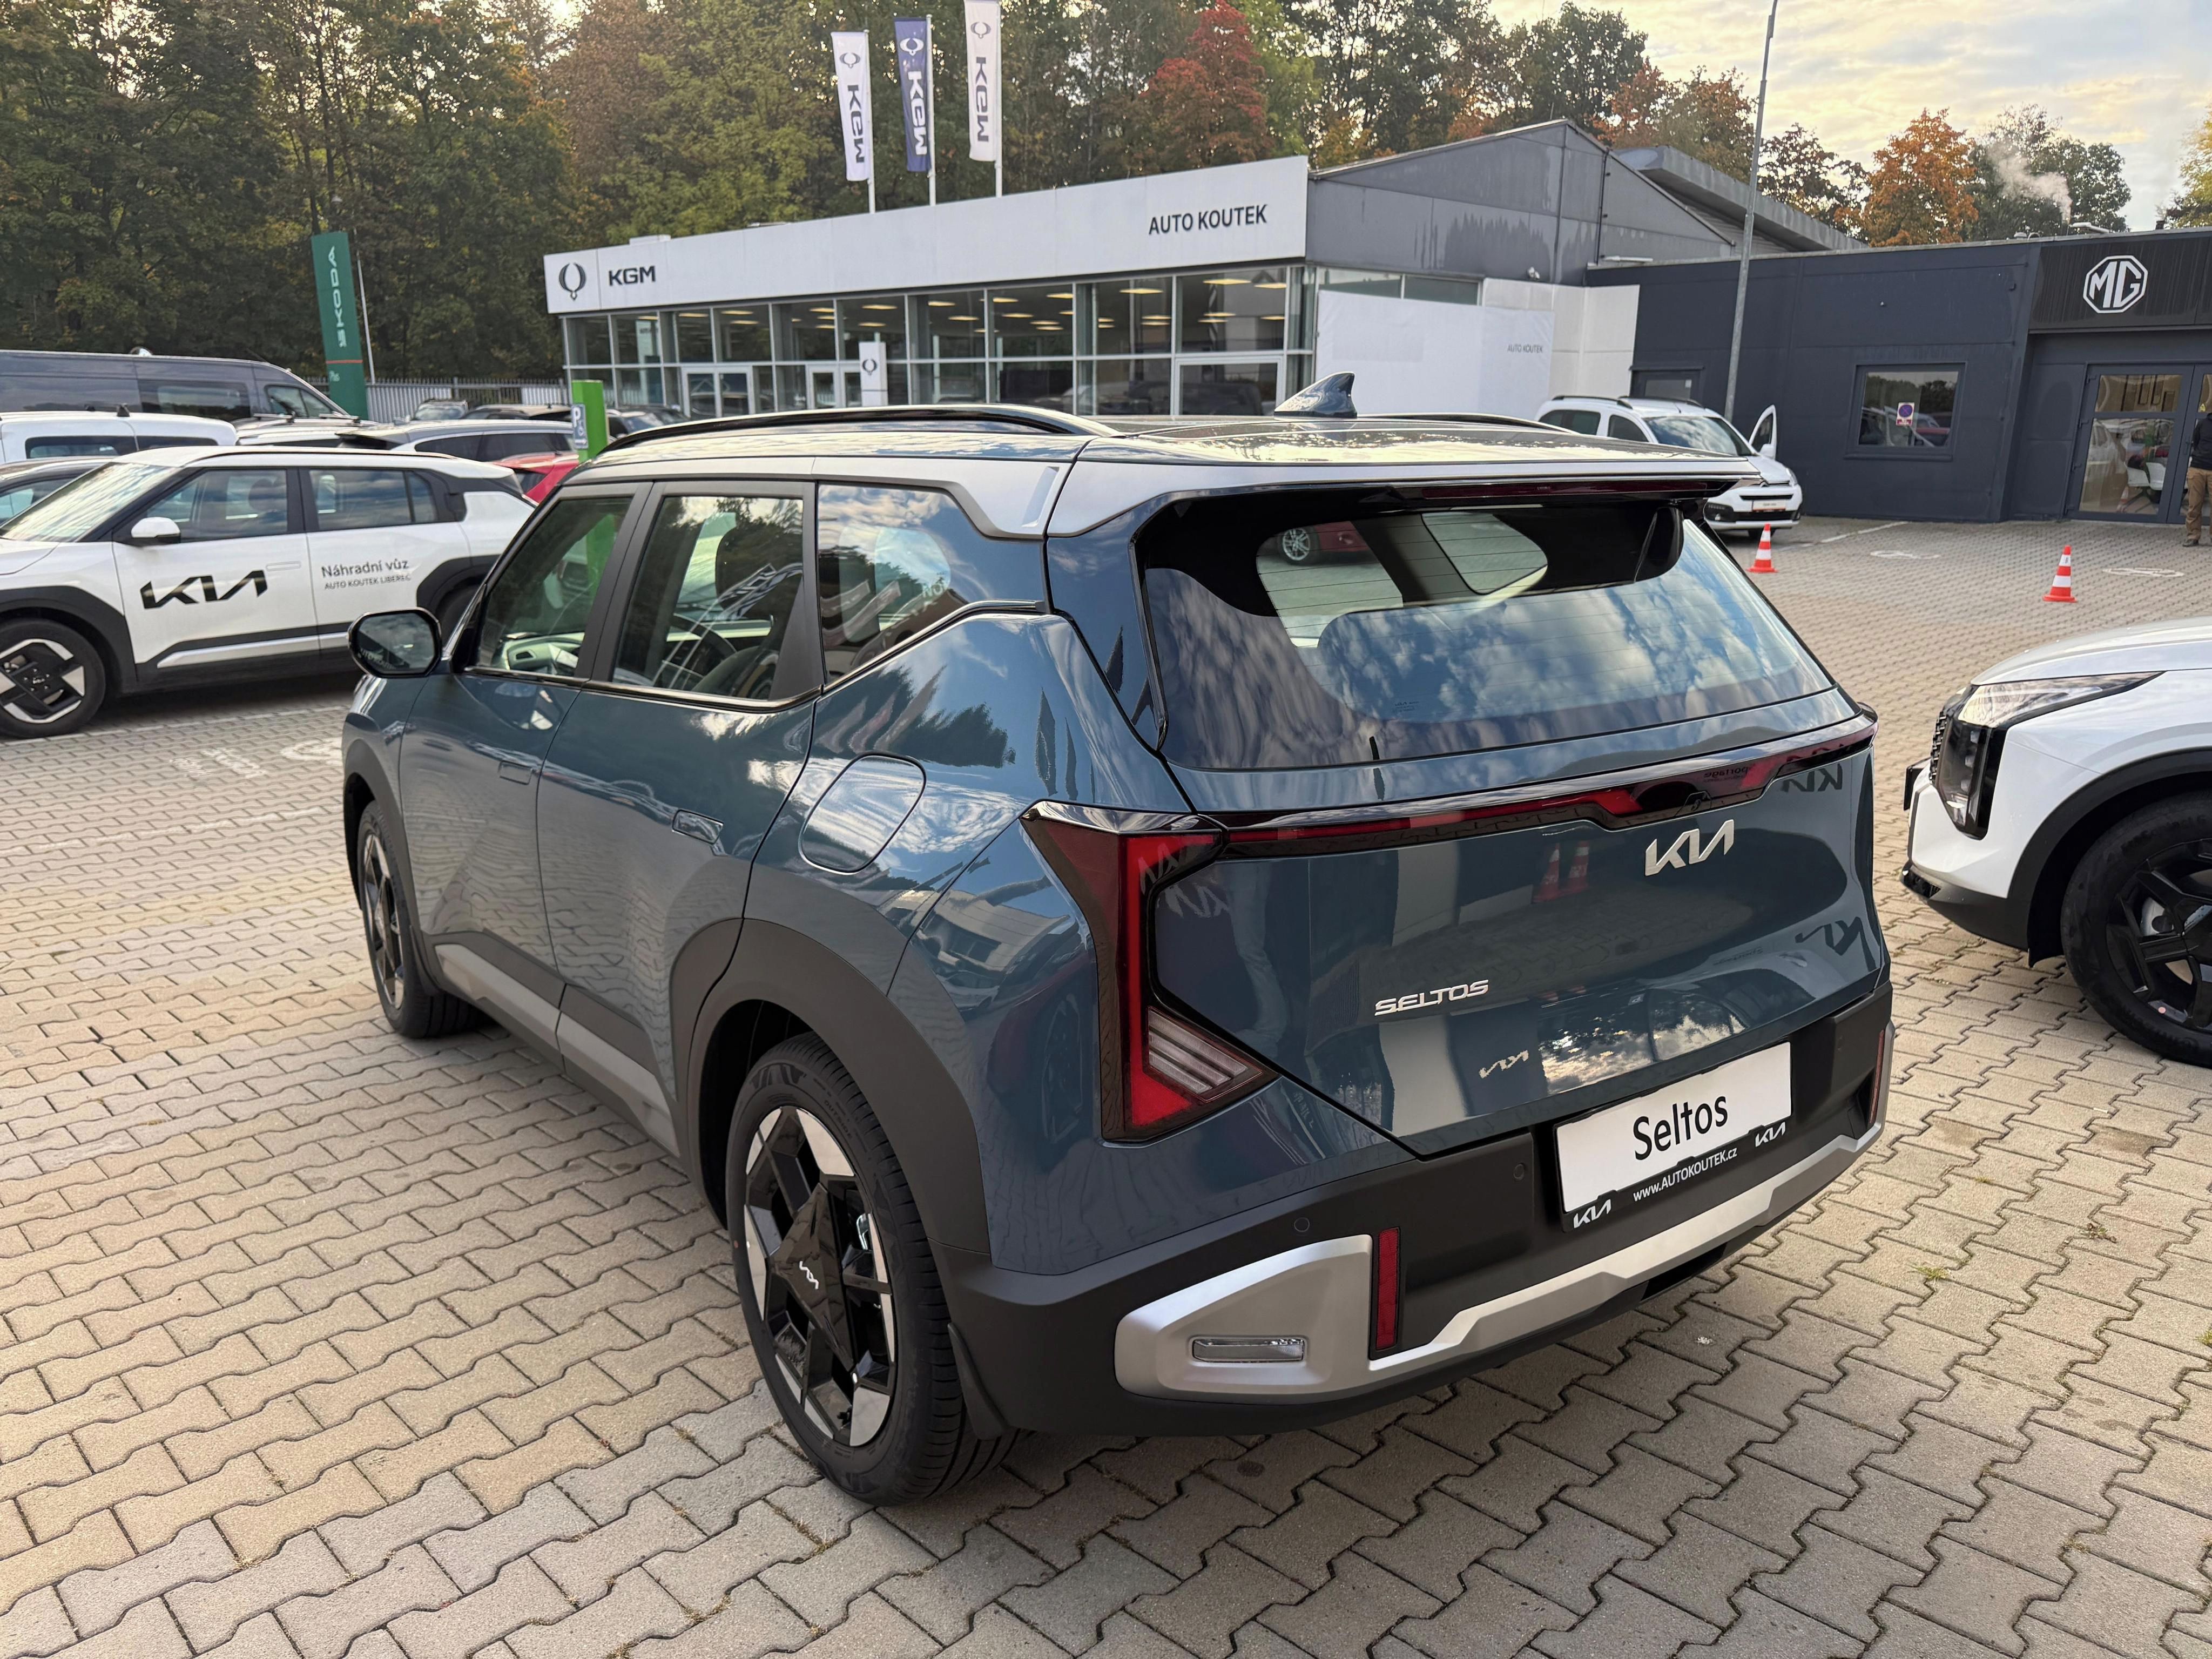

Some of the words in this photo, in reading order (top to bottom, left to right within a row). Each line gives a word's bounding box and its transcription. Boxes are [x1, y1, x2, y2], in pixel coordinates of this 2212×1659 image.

[907, 71, 927, 155] KGM
[975, 57, 989, 143] KGM
[847, 85, 865, 163] KGM
[1148, 213, 1193, 235] AUTO
[1198, 204, 1267, 230] KOUTEK
[609, 266, 656, 286] KGM
[2089, 261, 2142, 308] MG
[321, 560, 382, 578] Náhradní
[385, 558, 409, 571] vůz
[324, 580, 347, 590] AUTO
[348, 577, 379, 588] KOUTEK
[140, 569, 268, 609] KIA
[1644, 819, 1734, 876] KIA
[1374, 979, 1489, 1016] SELTOS
[1633, 1096, 1728, 1161] Seltos
[1755, 1121, 1786, 1148] KIA
[1633, 1147, 1737, 1202] www.AUTOKOUTEK.cz
[1573, 1198, 1612, 1229] KIA
